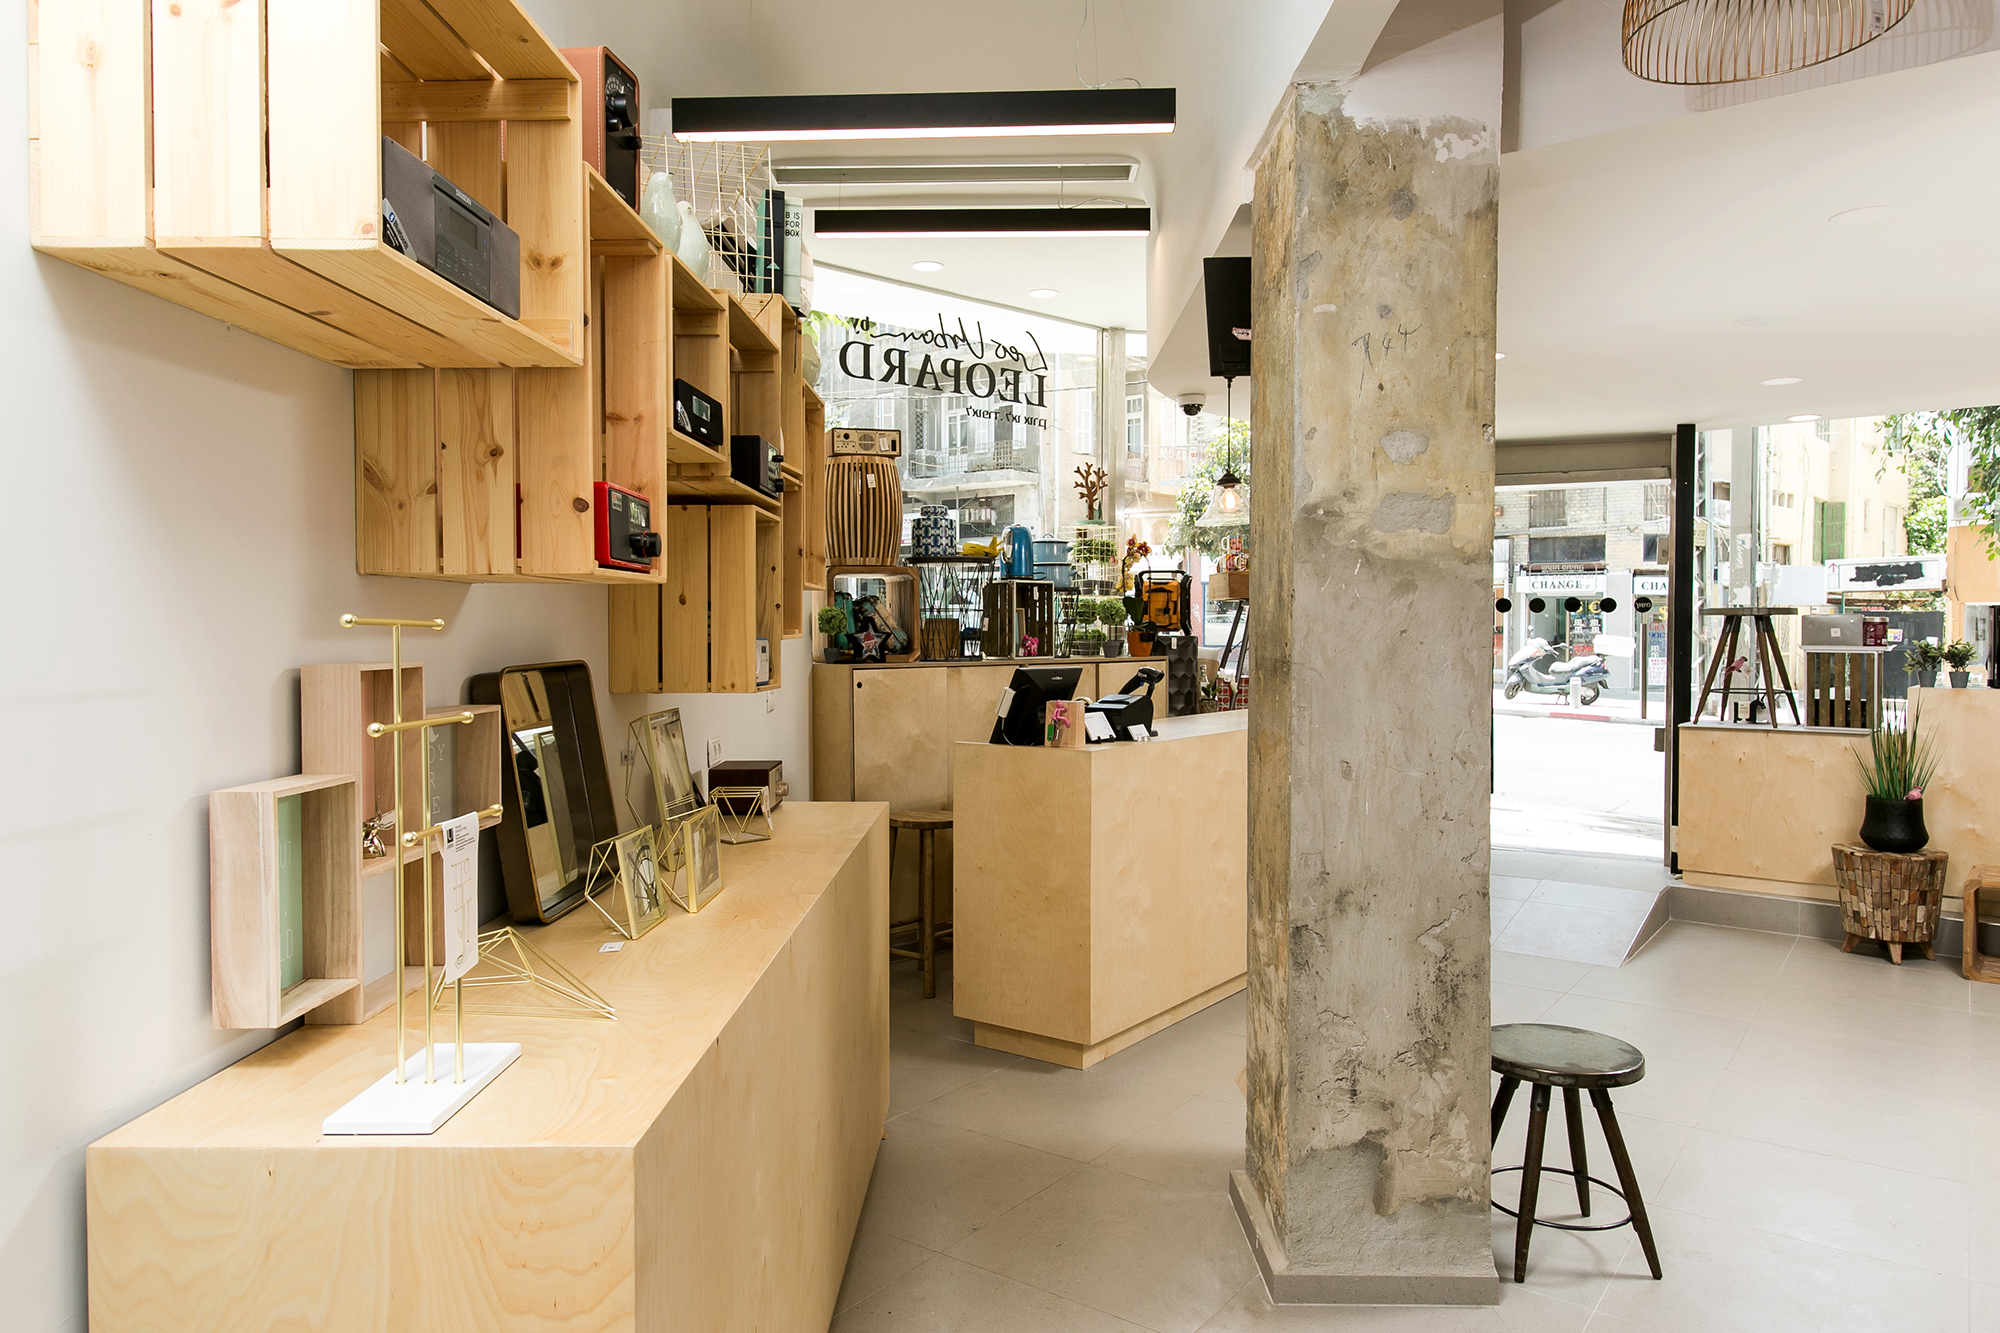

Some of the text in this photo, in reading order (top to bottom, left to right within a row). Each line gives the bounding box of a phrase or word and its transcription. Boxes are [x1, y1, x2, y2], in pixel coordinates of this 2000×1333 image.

[785, 211, 800, 220] B IS
[785, 220, 800, 229] FOR
[785, 229, 800, 237] BOX
[1531, 580, 1582, 590] CHANGE
